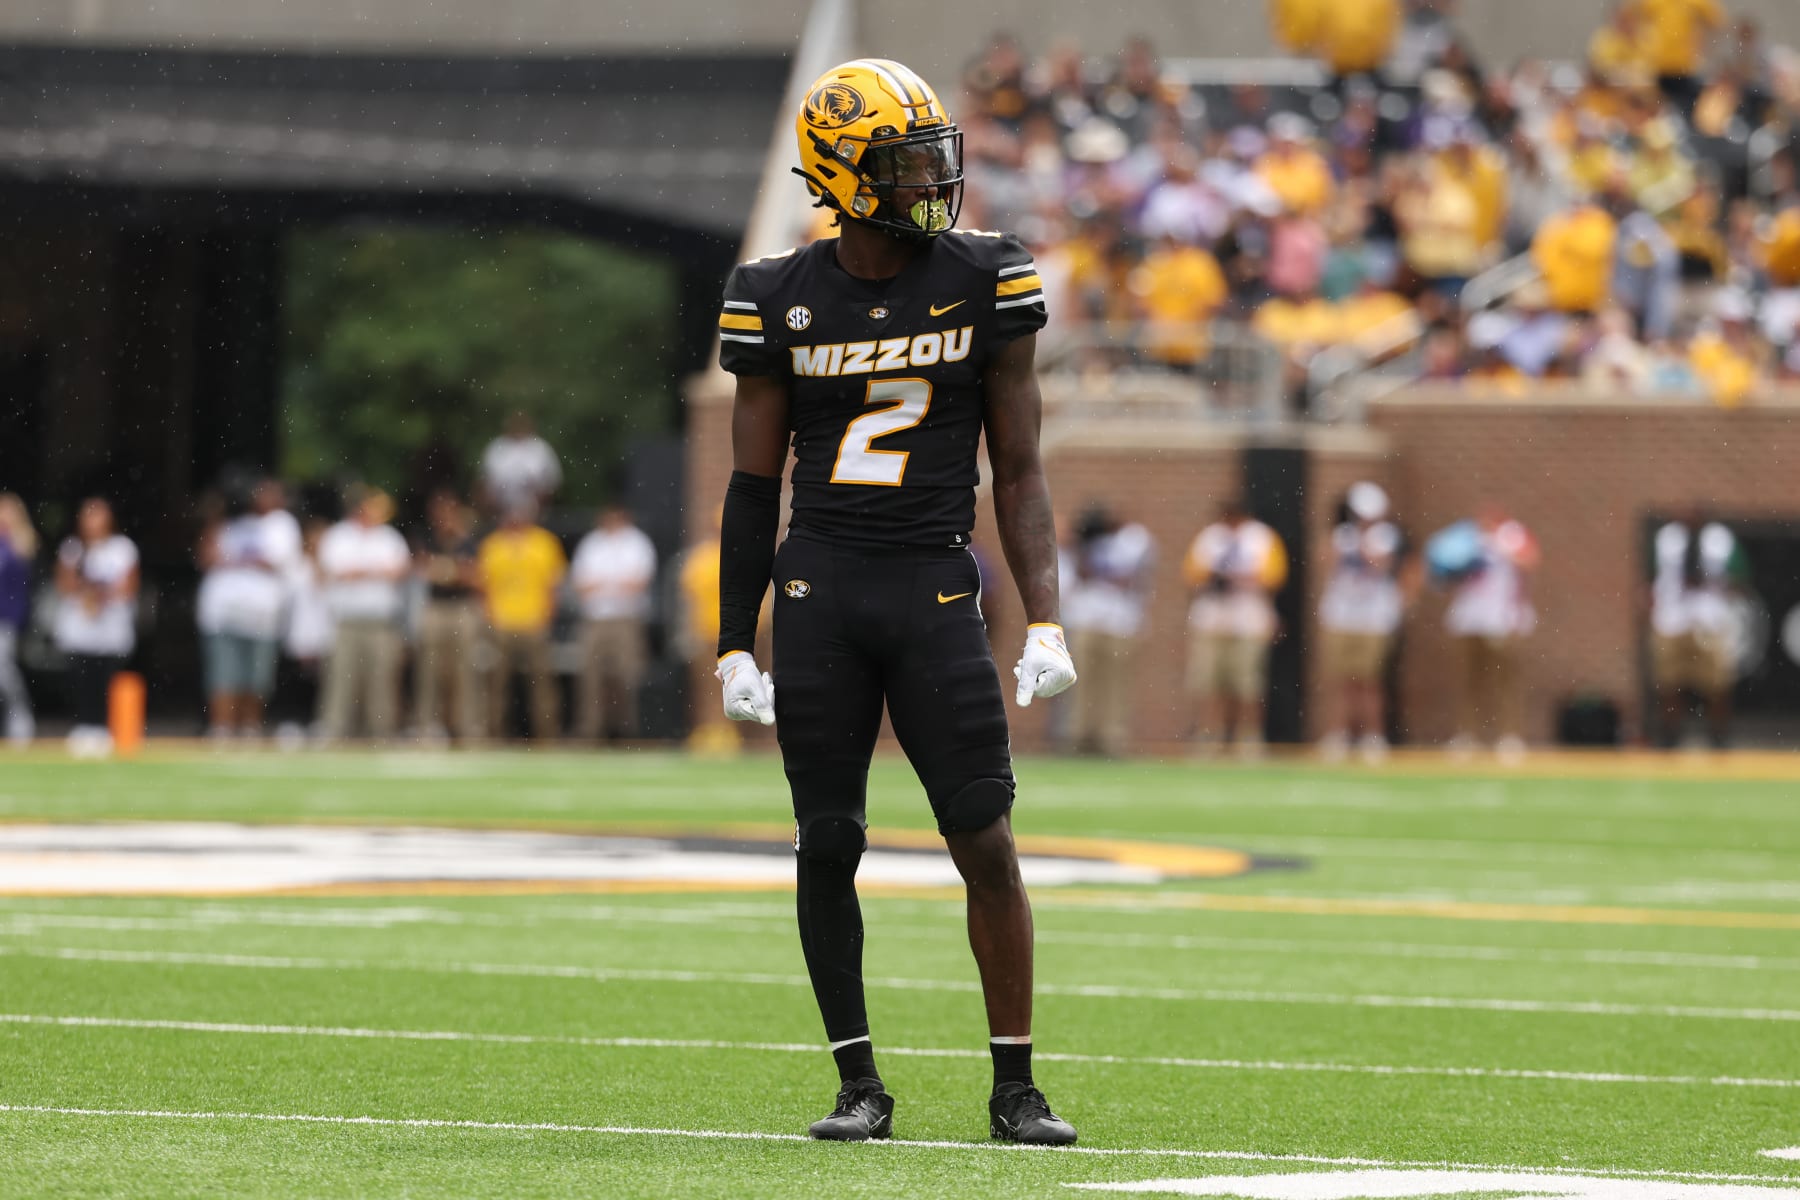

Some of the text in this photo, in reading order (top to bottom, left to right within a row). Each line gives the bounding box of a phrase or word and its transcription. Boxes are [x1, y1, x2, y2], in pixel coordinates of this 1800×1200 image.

[788, 308, 809, 328] SEC
[790, 326, 974, 376] MIZZOU
[829, 377, 933, 486] 2
